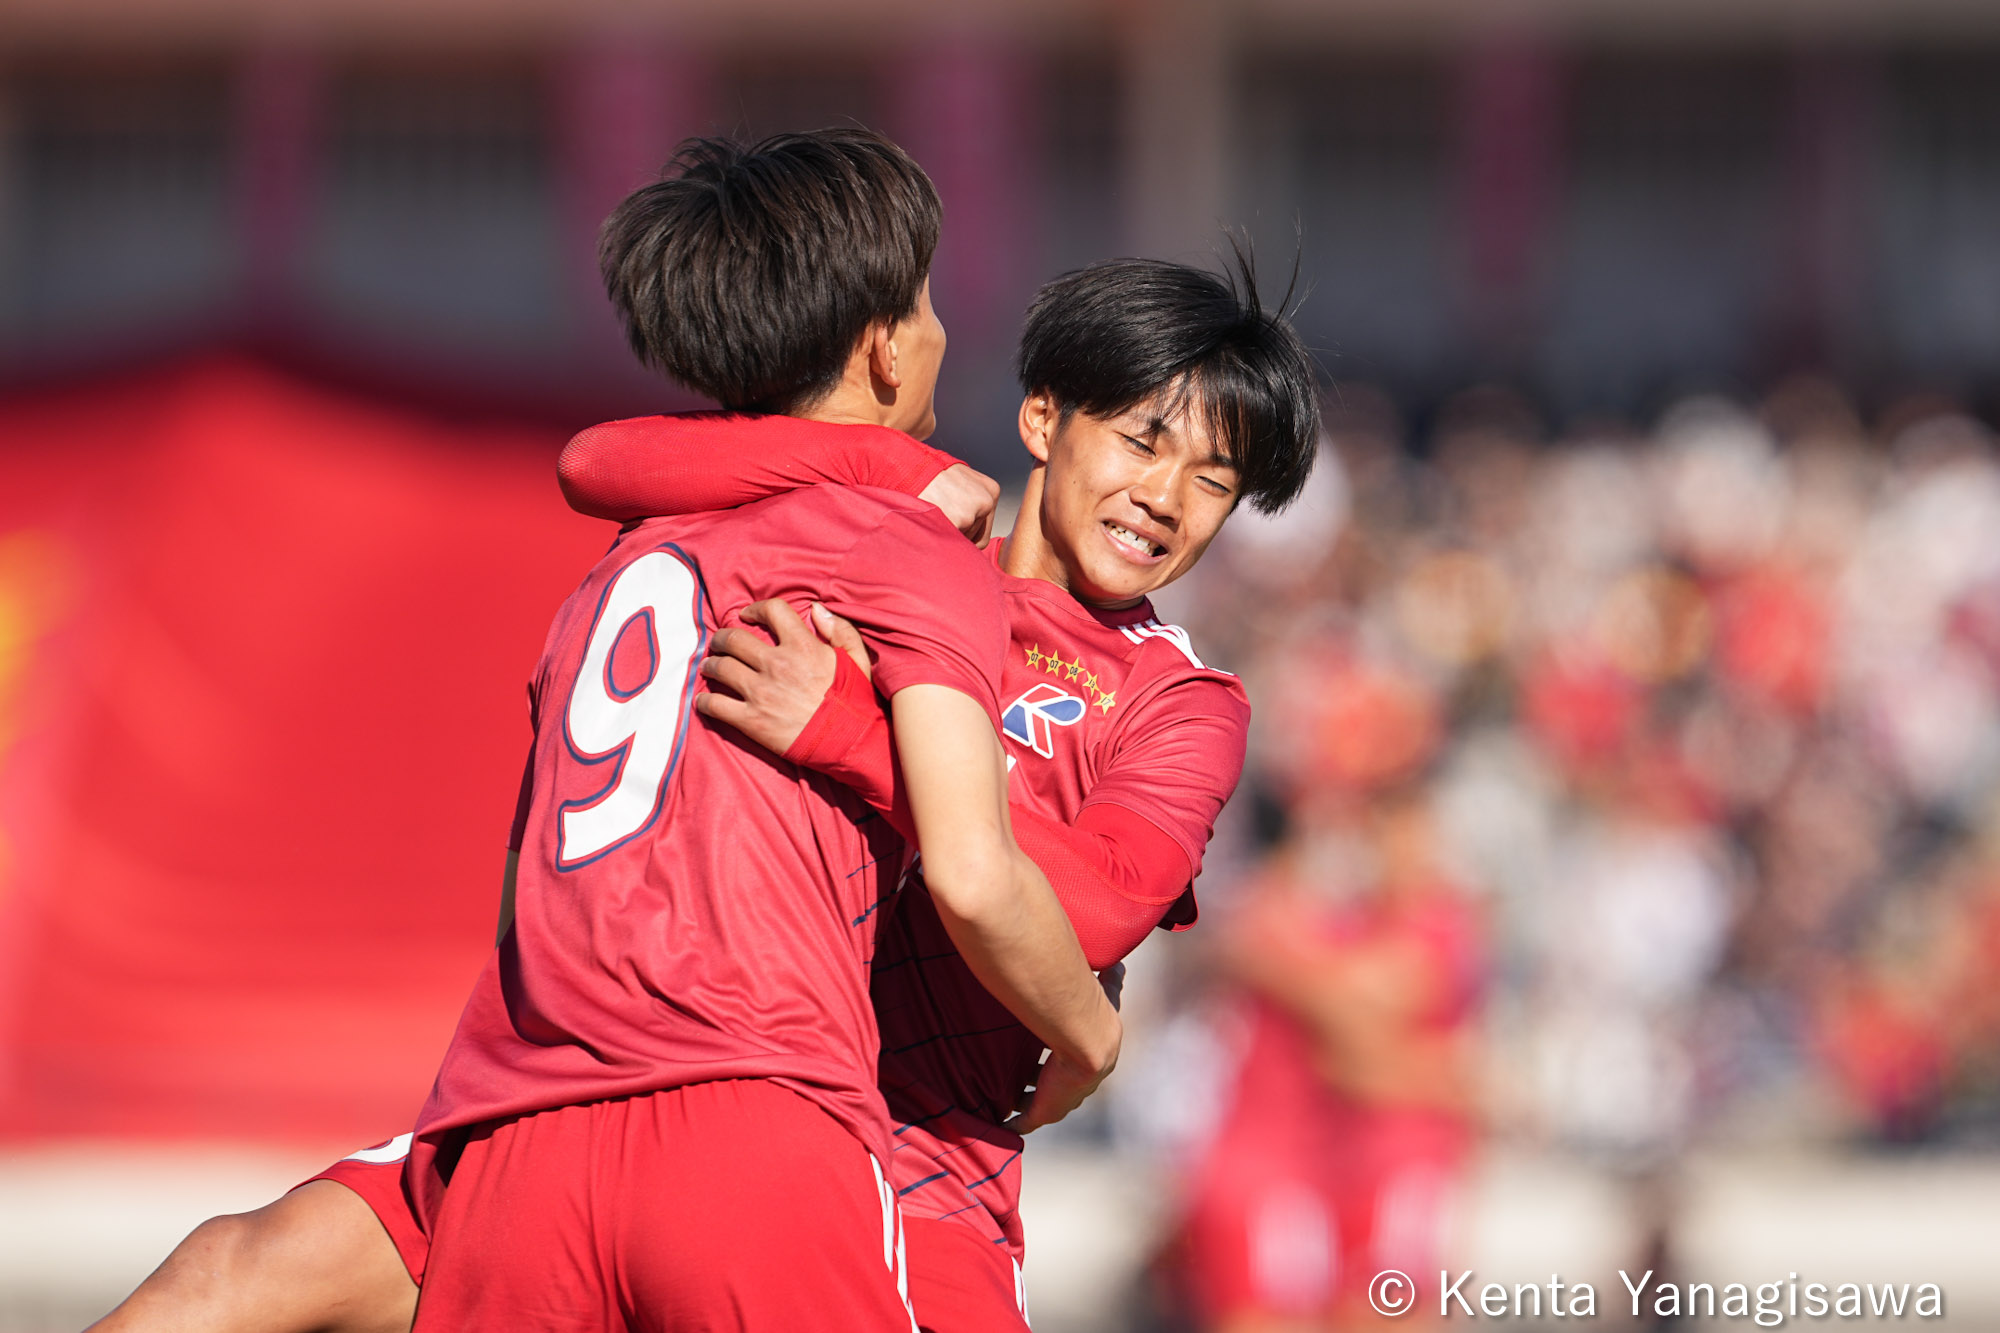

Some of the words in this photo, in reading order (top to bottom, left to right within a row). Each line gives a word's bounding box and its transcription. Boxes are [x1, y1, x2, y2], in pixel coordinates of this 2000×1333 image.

[557, 544, 705, 872] 9
[1030, 652, 1039, 663] 07
[1049, 659, 1060, 670] 07
[1100, 696, 1112, 706] 17
